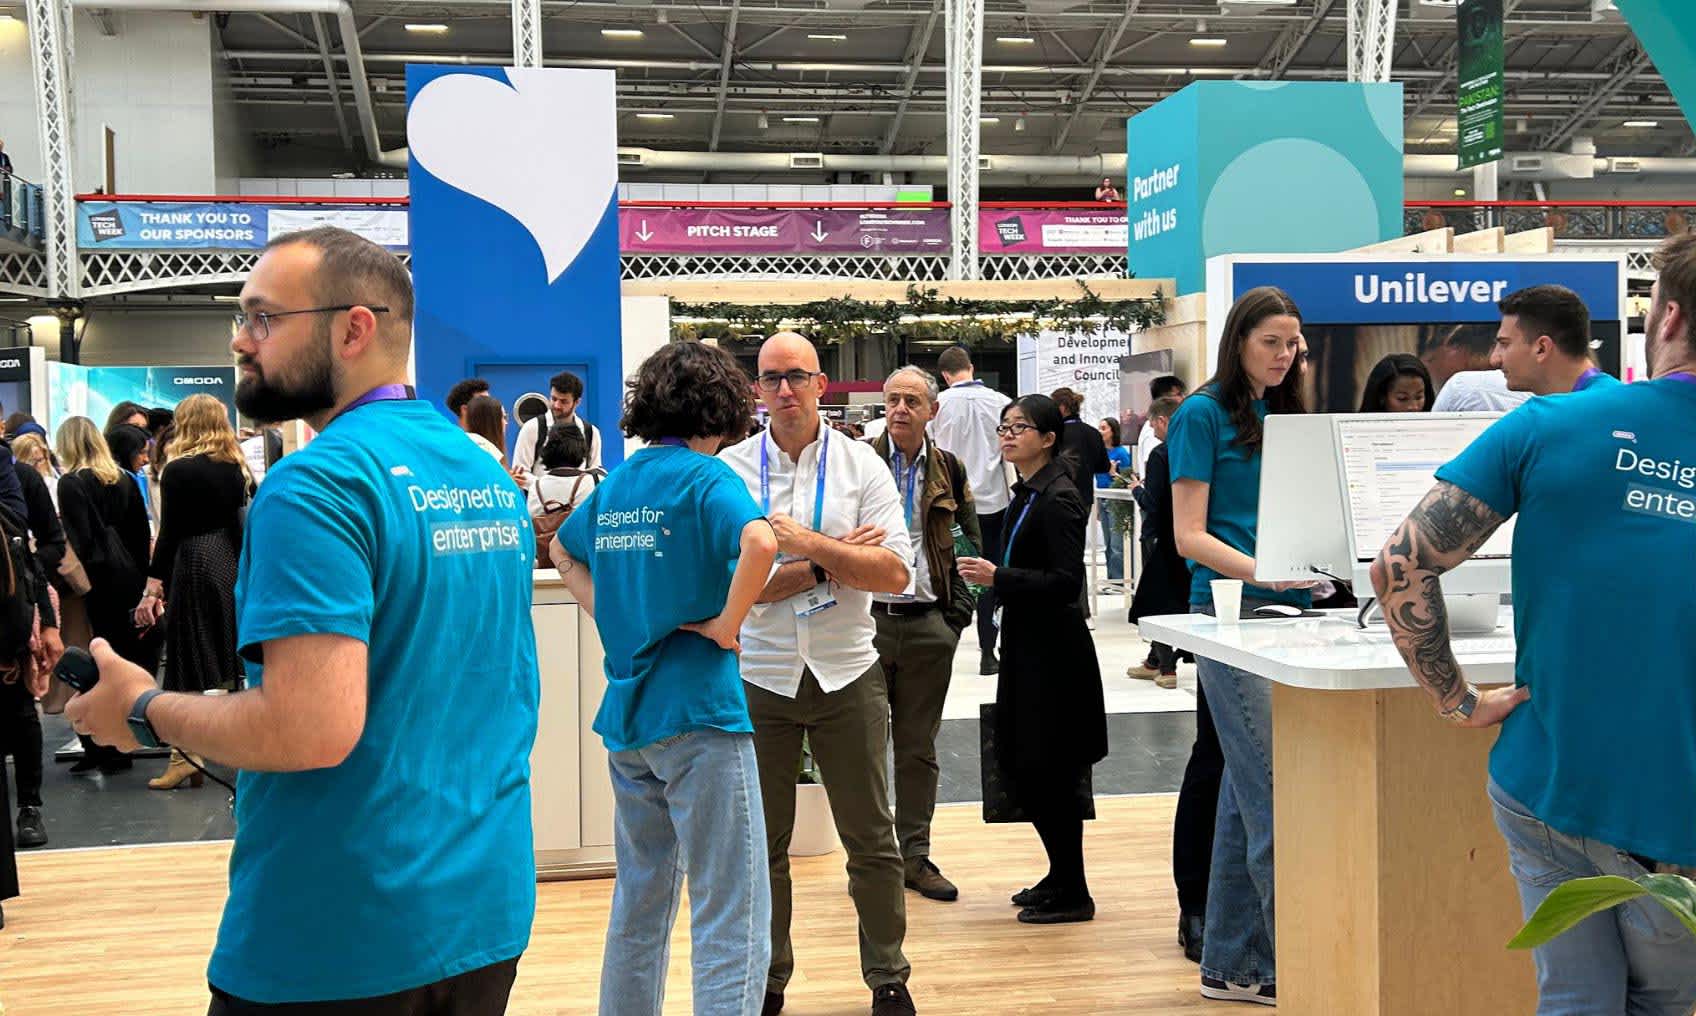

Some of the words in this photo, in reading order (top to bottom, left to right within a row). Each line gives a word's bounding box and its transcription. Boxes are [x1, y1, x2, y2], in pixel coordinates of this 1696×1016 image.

[1134, 164, 1180, 202] Partner
[140, 213, 192, 224] THANK
[196, 213, 227, 224] YOU
[229, 214, 251, 225] TO
[1092, 216, 1109, 224] YOU
[1109, 216, 1120, 224] TO
[1134, 208, 1160, 240] with
[1161, 208, 1177, 231] us
[97, 228, 123, 236] WEEK
[140, 229, 172, 240] OUR
[175, 229, 254, 240] SPONSORS
[687, 225, 731, 237] PITCH
[732, 225, 779, 237] STAGE
[1354, 272, 1508, 304] Unilever
[1053, 353, 1076, 365] and
[1079, 353, 1126, 365] Innova
[173, 377, 223, 385] OMODA
[1074, 369, 1121, 381] Council
[1615, 447, 1696, 489] Desig
[407, 484, 494, 514] Designed
[493, 483, 516, 509] for
[1626, 489, 1696, 518] ente
[597, 507, 640, 528] esigned
[641, 505, 665, 524] for
[432, 521, 520, 551] enterprise
[594, 531, 655, 551] enterprise
